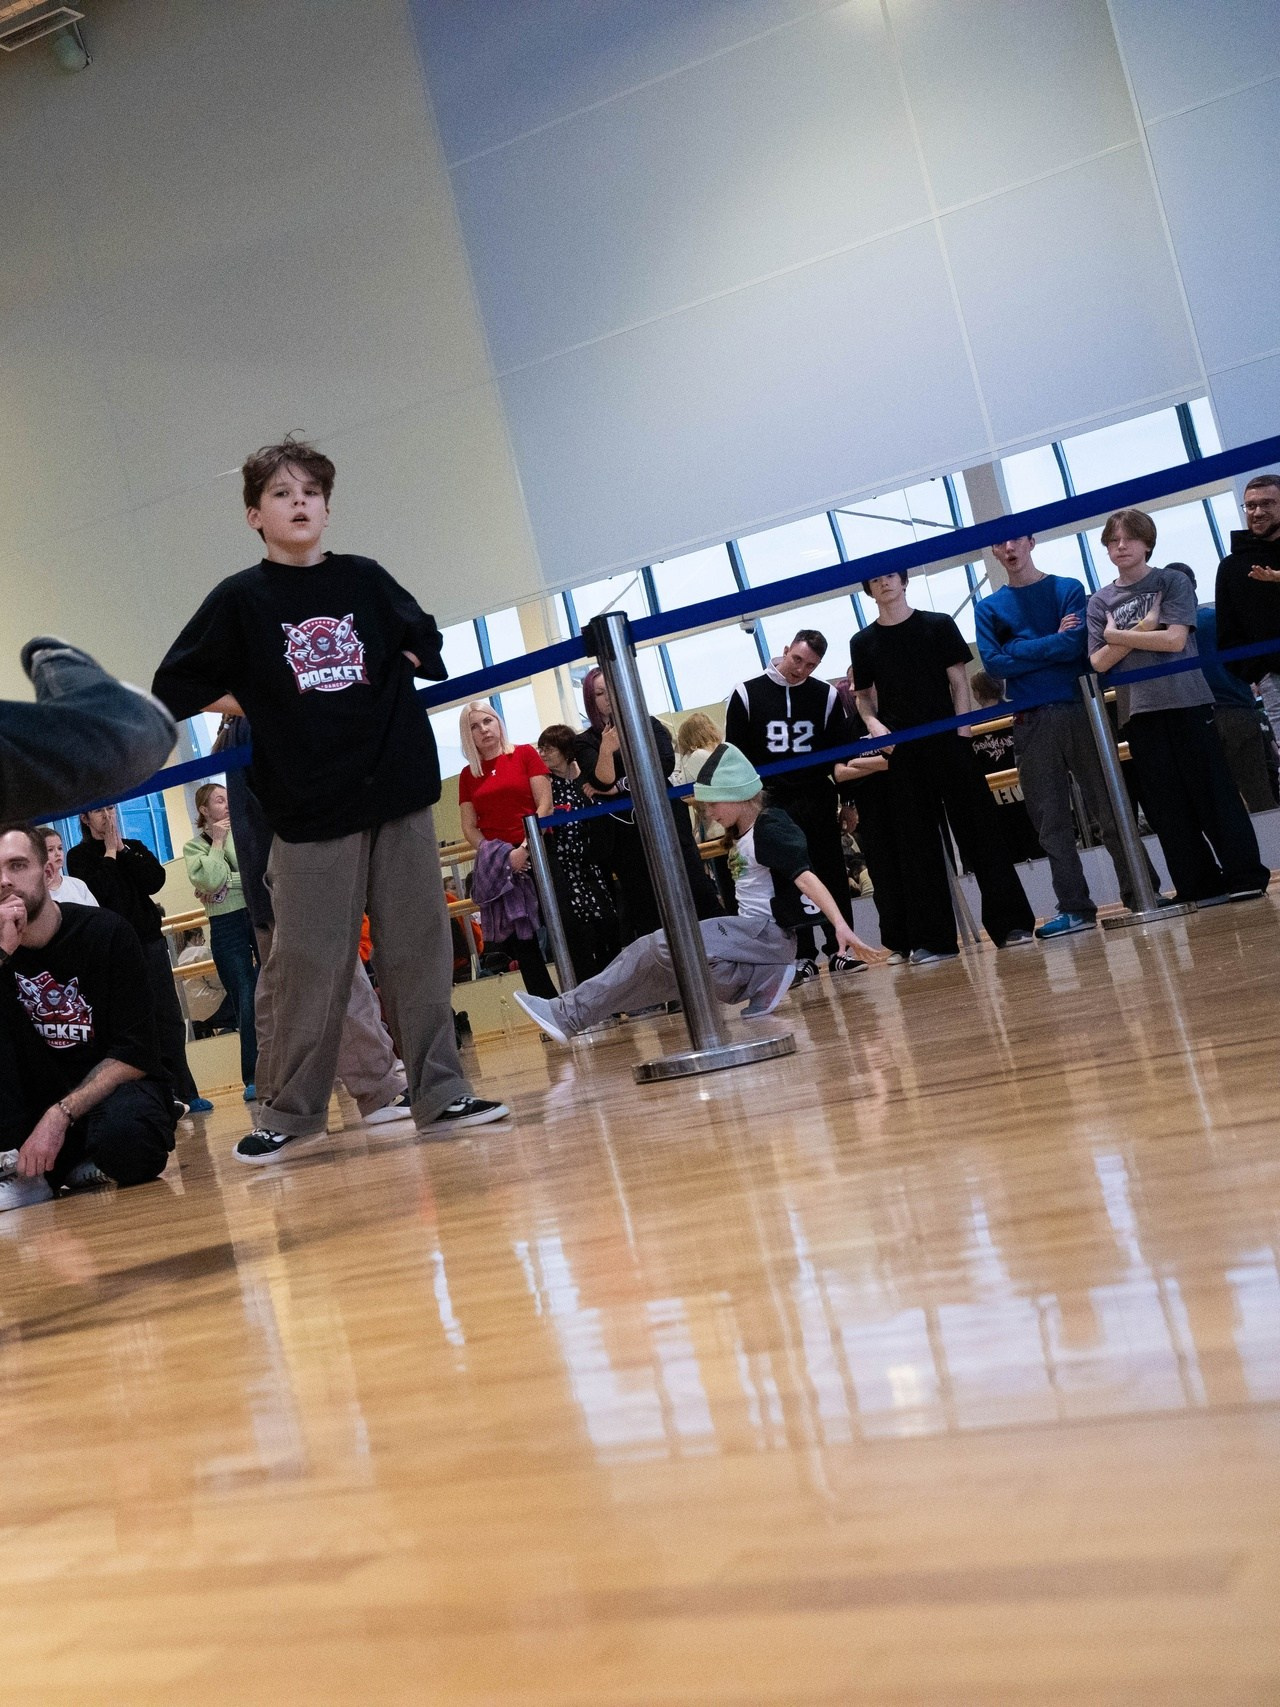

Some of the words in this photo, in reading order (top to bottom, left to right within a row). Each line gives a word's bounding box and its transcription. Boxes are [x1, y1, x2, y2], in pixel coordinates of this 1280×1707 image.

[298, 665, 363, 689] ROCKET
[766, 720, 814, 753] 92
[33, 1023, 91, 1042] CKET
